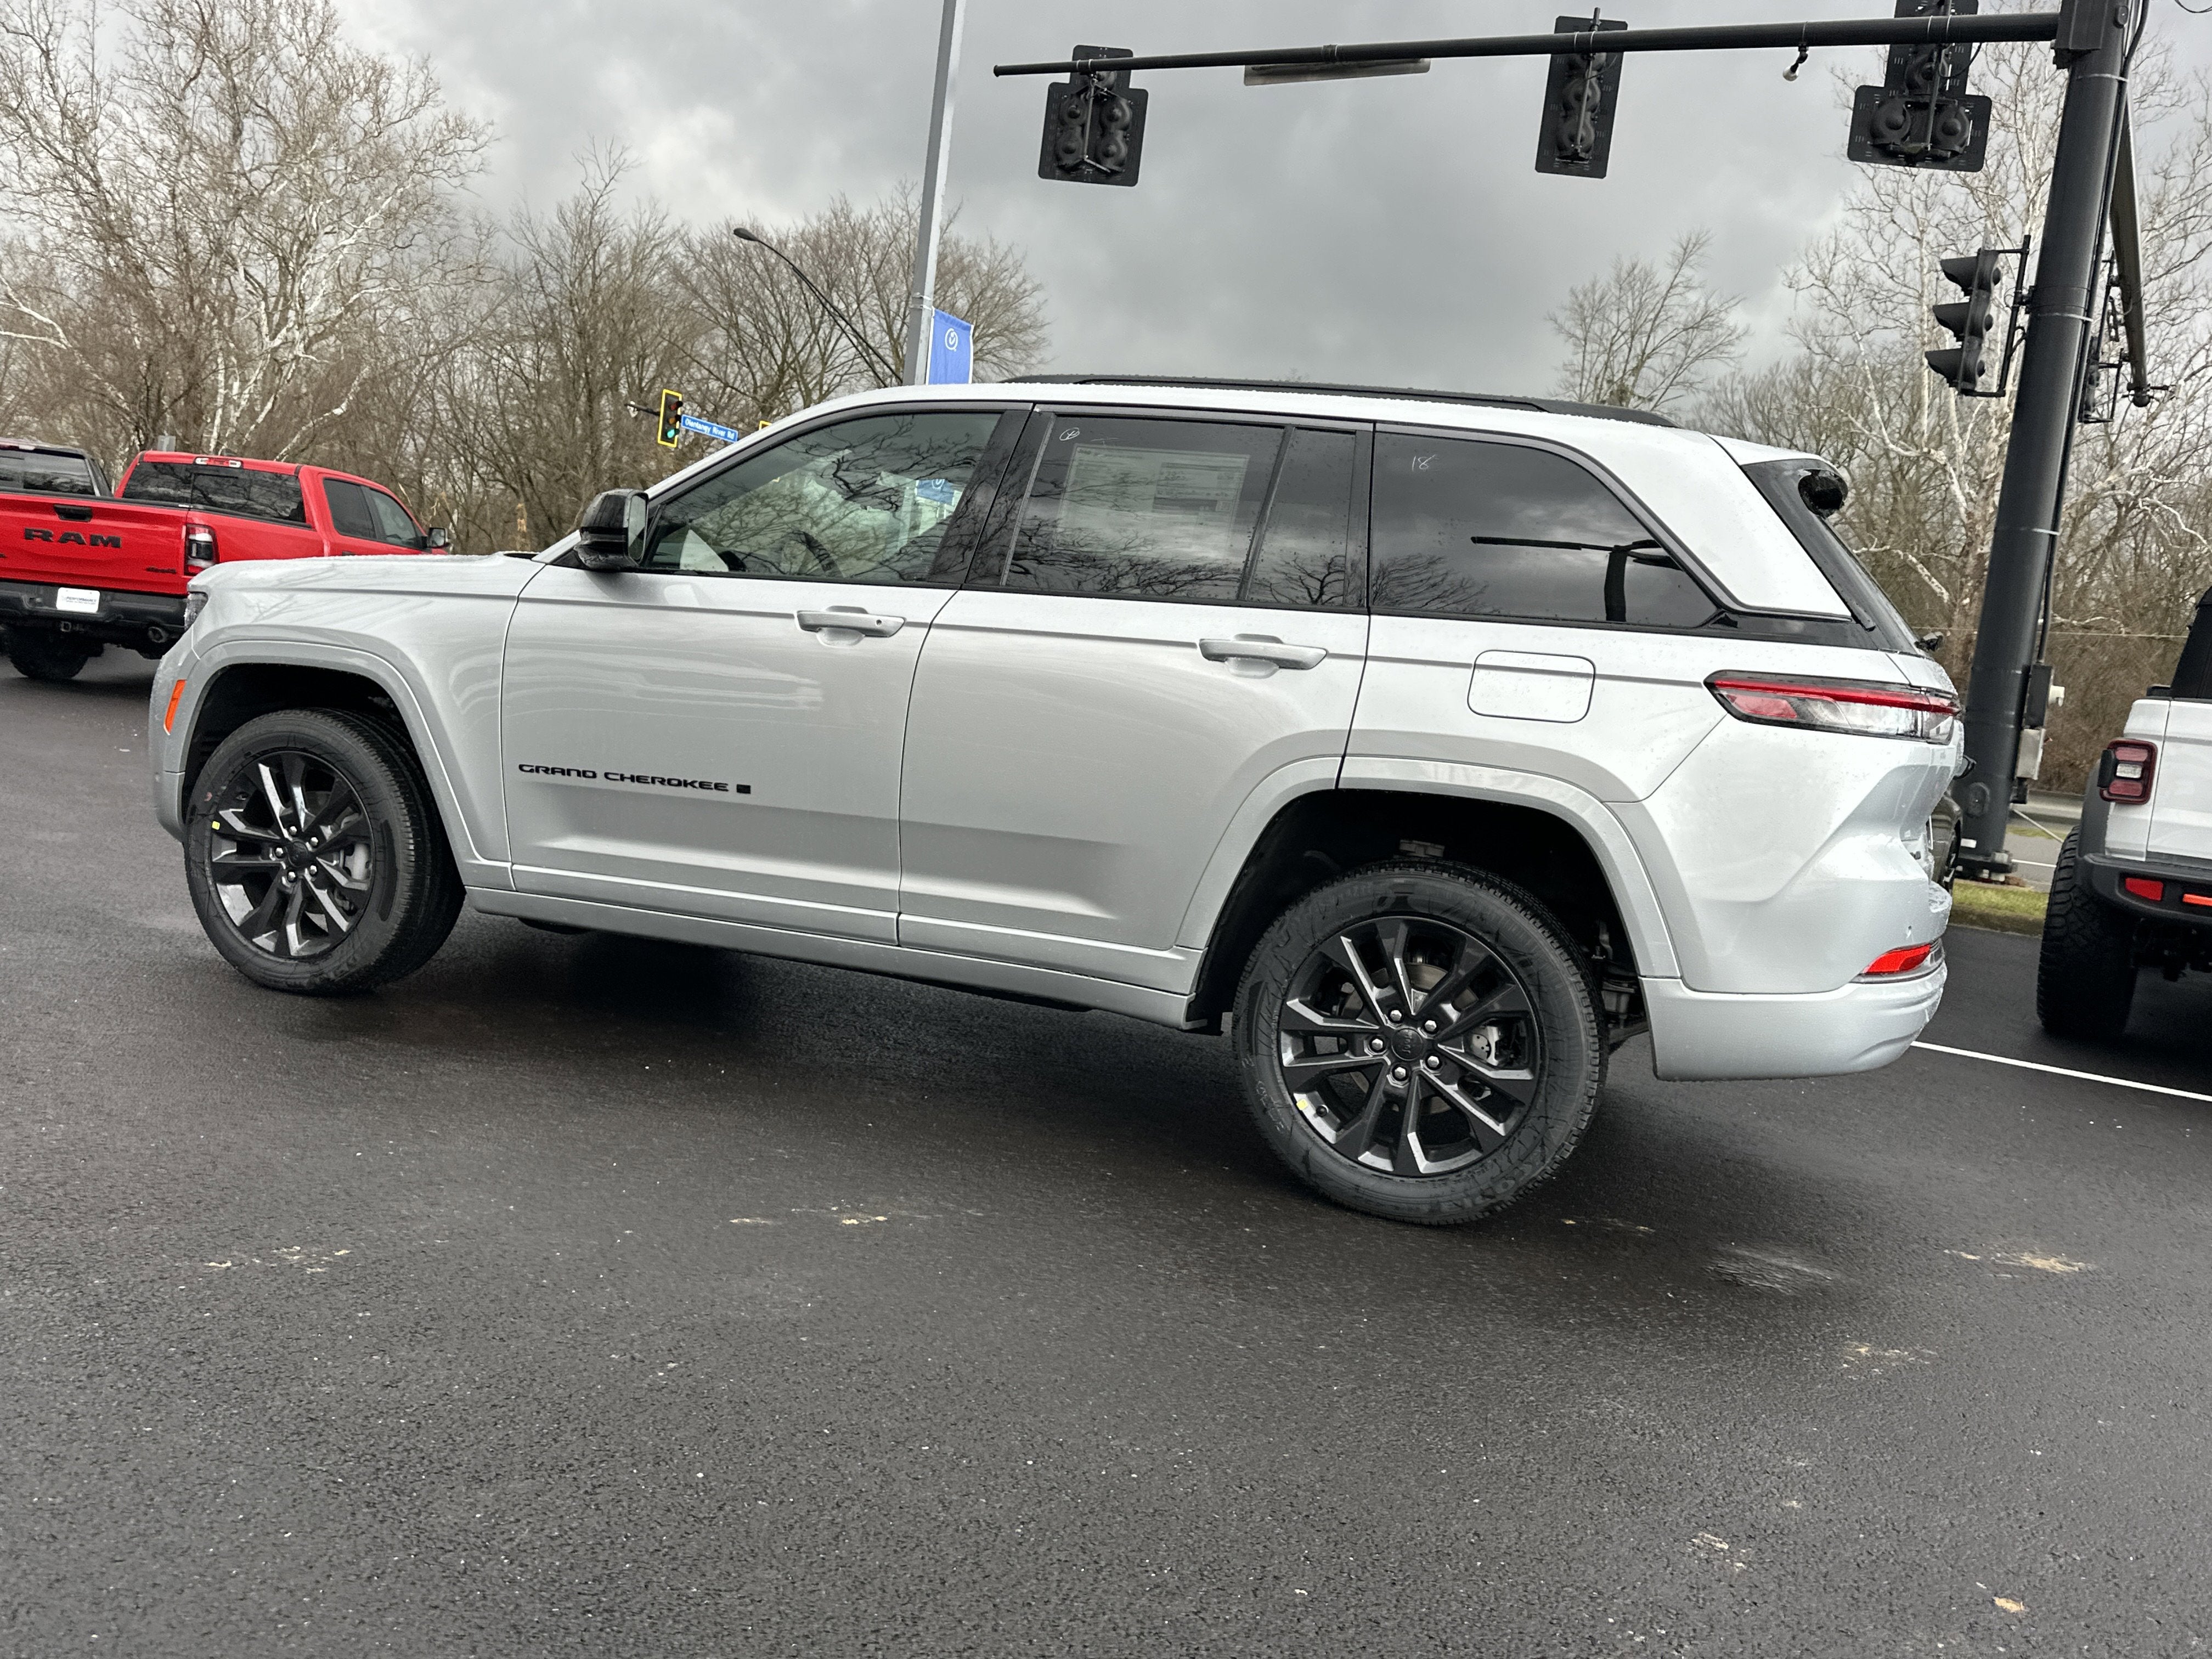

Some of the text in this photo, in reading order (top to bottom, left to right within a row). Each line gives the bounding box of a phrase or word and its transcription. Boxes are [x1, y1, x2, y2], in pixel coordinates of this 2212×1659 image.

[685, 418, 735, 439] Olentangy River Rd
[24, 527, 121, 548] RAM
[518, 764, 729, 792] GRAND CHEROKEE
